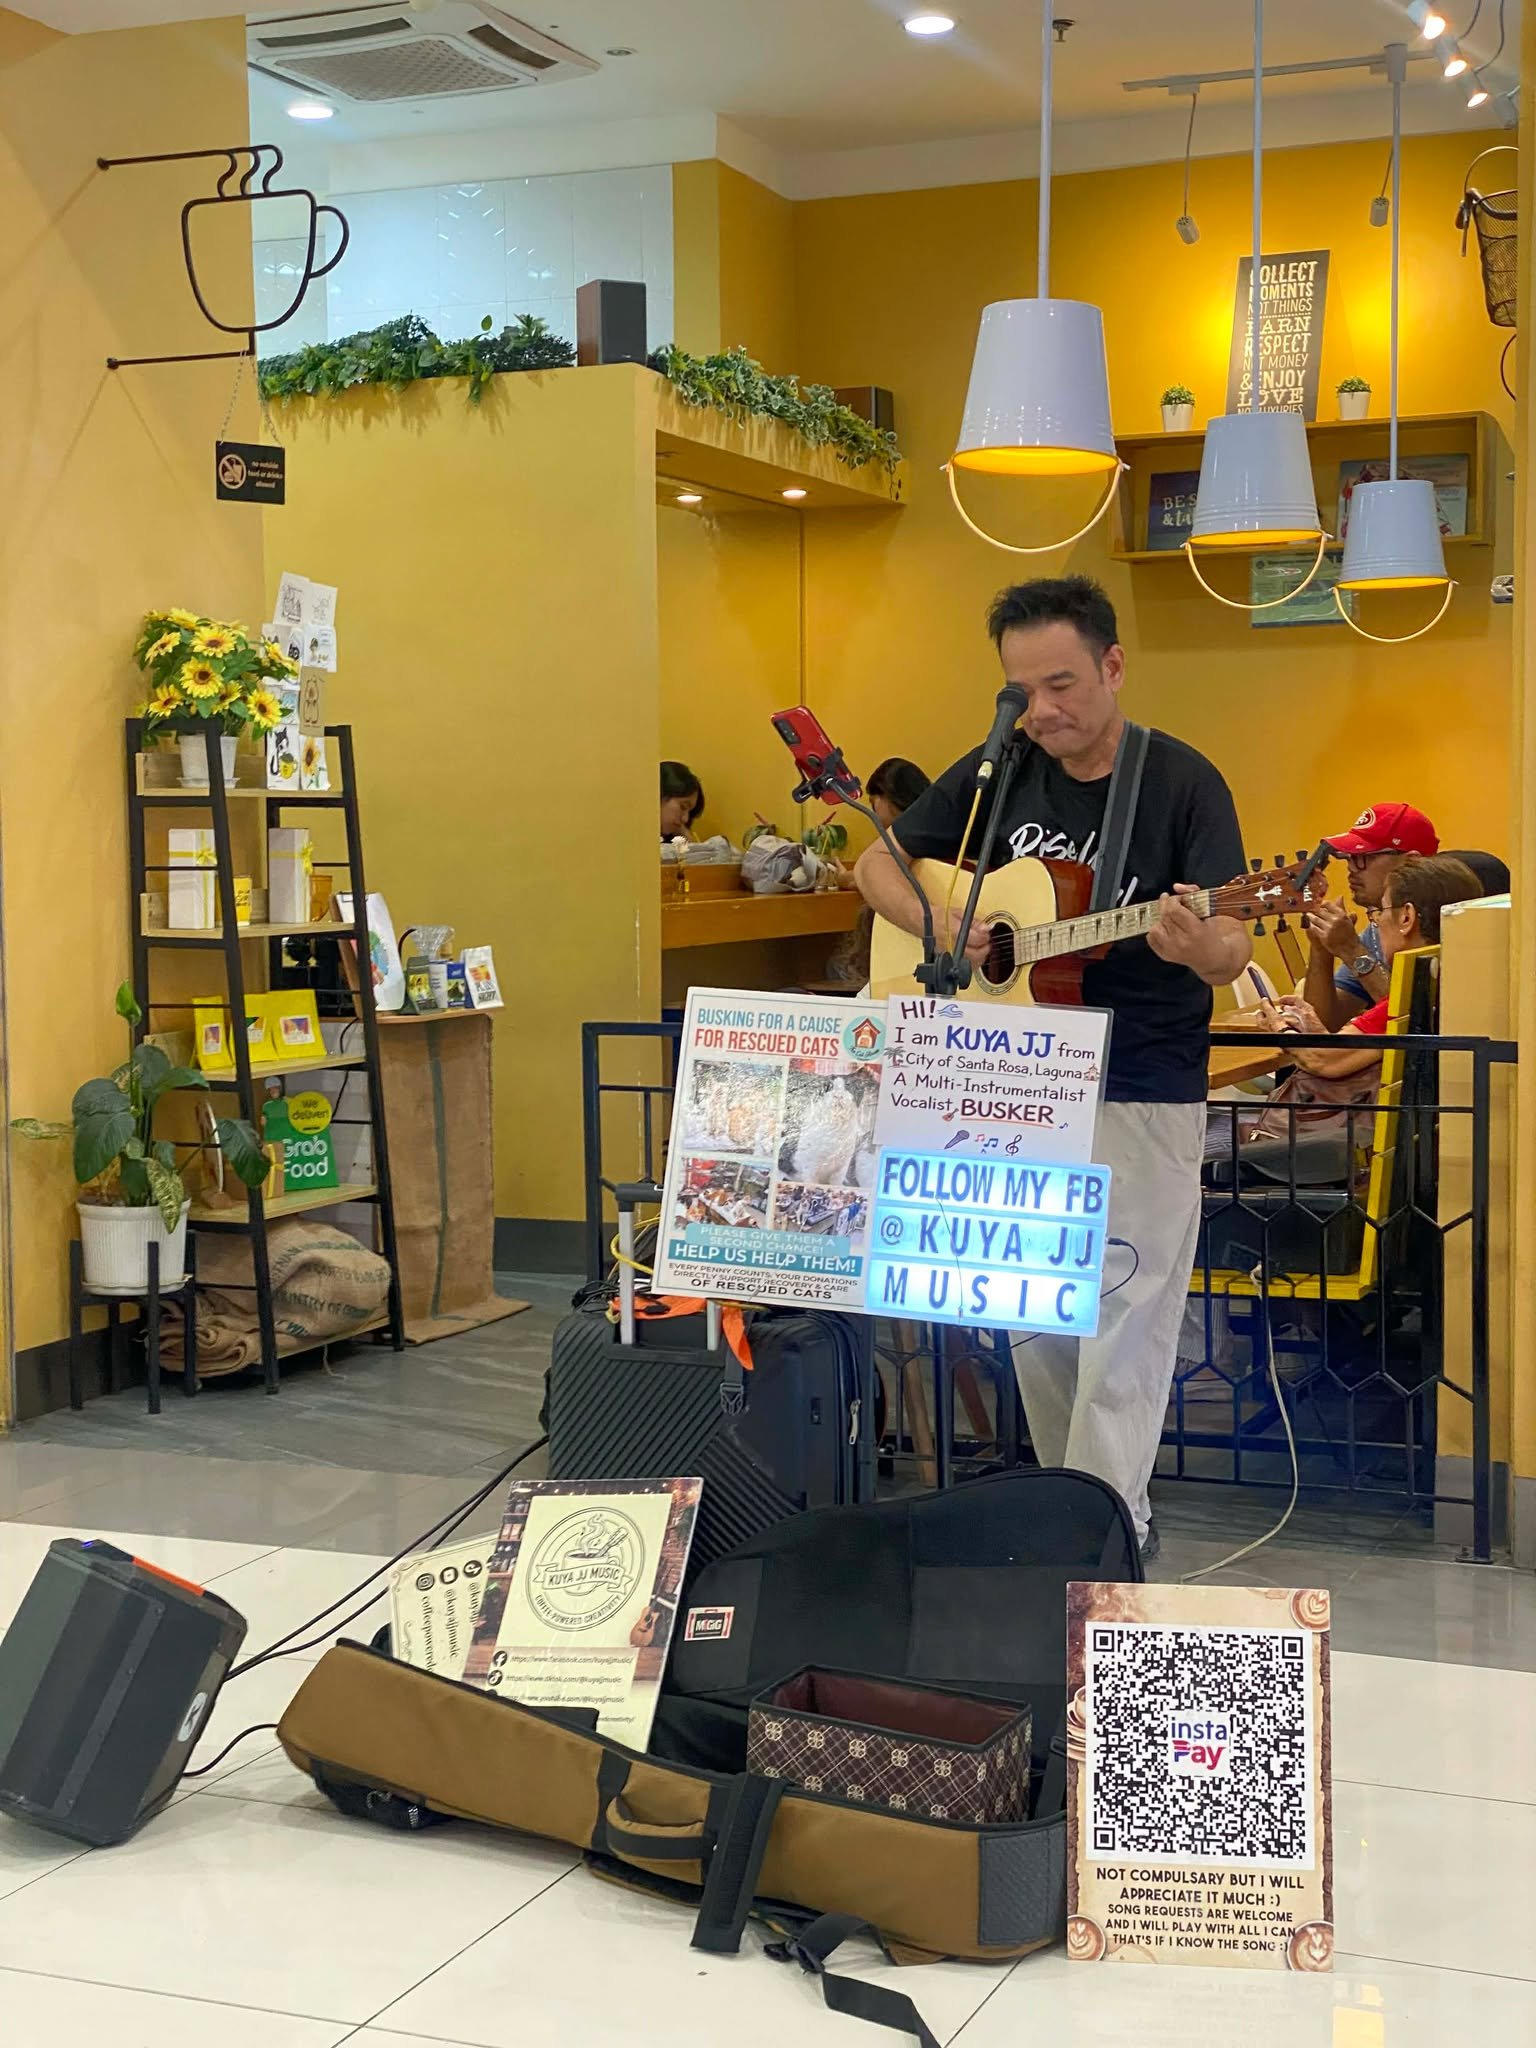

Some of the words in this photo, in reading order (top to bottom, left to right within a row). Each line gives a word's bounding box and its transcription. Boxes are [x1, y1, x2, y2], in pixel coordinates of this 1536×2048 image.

[1273, 298, 1313, 314] THINGS
[1243, 356, 1264, 371] NT
[1269, 354, 1308, 369] MONEY
[1240, 373, 1253, 391] &
[698, 1008, 754, 1028] BUSKING
[758, 1013, 783, 1029] FOR
[786, 1015, 795, 1030] A
[799, 1015, 842, 1033] CAUSE
[901, 1000, 936, 1020] HI!
[695, 1029, 723, 1048] FOR
[727, 1030, 797, 1054] RESCUED
[800, 1036, 839, 1057] CATS
[895, 1026, 905, 1044] I
[911, 1033, 938, 1046] am
[946, 1025, 1010, 1053] KUYA
[1017, 1032, 1056, 1057] JJ
[1058, 1043, 1095, 1060] from
[906, 1053, 934, 1069] City
[938, 1056, 953, 1067] of
[956, 1056, 994, 1071] Santa
[999, 1060, 1032, 1076] Rosa,
[1035, 1063, 1082, 1081] Laguna
[893, 1072, 906, 1086] A
[915, 1074, 1086, 1102] Multi-Instrumentalist
[961, 1098, 1054, 1123] BUSKER
[282, 1135, 327, 1157] Grab
[284, 1156, 328, 1178] Food
[882, 1157, 994, 1203] FOLLOW
[1003, 1167, 1051, 1209] MY
[1065, 1174, 1103, 1214] FB
[700, 1226, 748, 1239] PLEASE
[751, 1230, 780, 1241] GIVE
[785, 1234, 823, 1245] THEM
[826, 1238, 835, 1246] A
[709, 1236, 762, 1249] SECOND
[766, 1241, 823, 1255] CHANCE!
[881, 1215, 904, 1245] @
[919, 1214, 1023, 1262] KUYA
[1048, 1227, 1093, 1266] JJ
[674, 1243, 720, 1259] HELP
[724, 1249, 747, 1262] US
[751, 1251, 796, 1267] HELP
[801, 1256, 856, 1273] THEM!
[669, 1262, 699, 1271] EVERY
[700, 1265, 732, 1274] PENNY
[775, 1272, 800, 1281] YOUR
[803, 1275, 858, 1286] DONATIONS
[673, 1271, 718, 1280] DIRECTLY
[719, 1274, 761, 1284] SUPPORT
[824, 1285, 848, 1293] CARE
[691, 1279, 712, 1288] OF
[716, 1282, 787, 1295] RESCUED
[793, 1289, 832, 1299] CATS
[548, 1572, 574, 1586] KUYA
[590, 1568, 620, 1580] MUSIC
[1171, 1717, 1228, 1741] insta
[1173, 1741, 1224, 1769] Pay
[1097, 1868, 1126, 1881] NOT
[1130, 1869, 1224, 1886] COMPULSARY
[1230, 1874, 1255, 1887] BUT
[1260, 1876, 1264, 1887] I
[1269, 1876, 1304, 1889] WILL
[1120, 1888, 1201, 1903] APPRECIATE
[1208, 1891, 1218, 1903] IT
[1223, 1892, 1264, 1906] MUCH
[1270, 1895, 1281, 1907] :)
[1108, 1904, 1140, 1915] SONG
[1145, 1906, 1203, 1918] REQUESTS
[1207, 1909, 1229, 1919] ARE
[1233, 1910, 1292, 1922] WELCOME
[1105, 1919, 1130, 1929] AND
[1133, 1920, 1136, 1930] I
[1140, 1920, 1168, 1931] WILL
[1173, 1922, 1201, 1933] PLAY
[1205, 1924, 1235, 1934] WITH
[1238, 1925, 1260, 1936] ALL
[1264, 1927, 1268, 1936] I
[1271, 1927, 1296, 1938] CAN
[1113, 1934, 1151, 1945] THAT'S
[1156, 1935, 1164, 1945] IF
[1169, 1936, 1172, 1946] I
[1176, 1937, 1214, 1948] KNOW
[1218, 1939, 1239, 1949] THE
[1243, 1940, 1275, 1951] SONG
